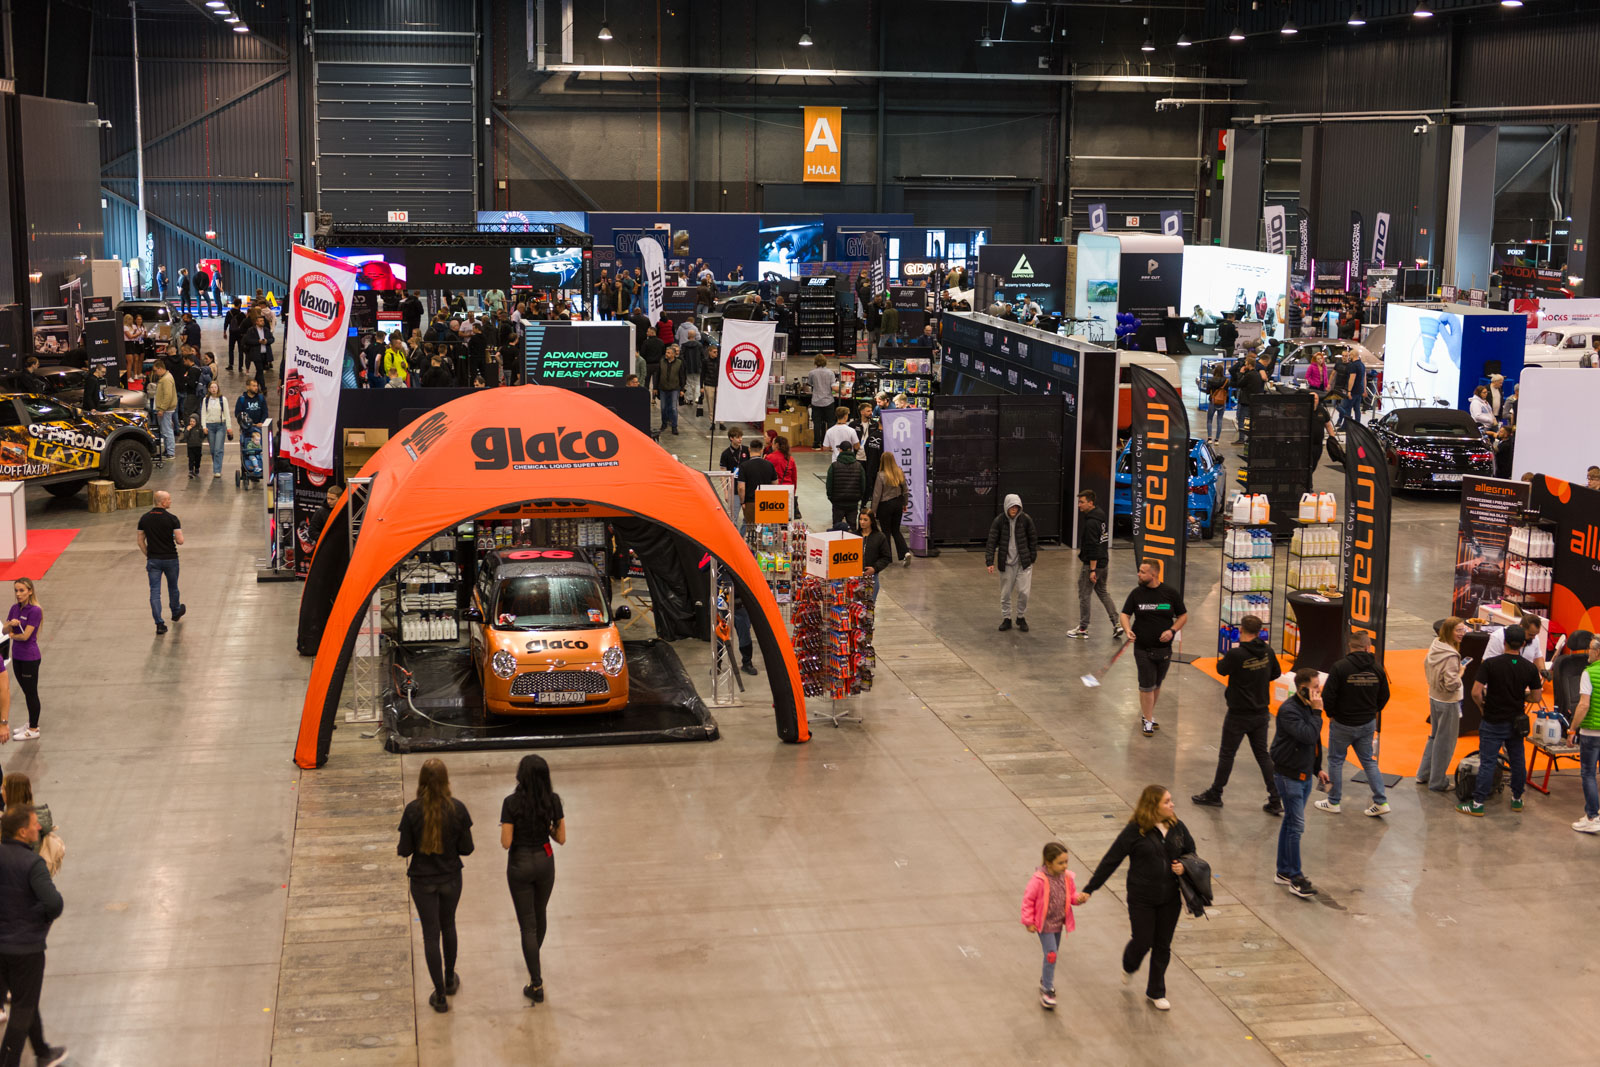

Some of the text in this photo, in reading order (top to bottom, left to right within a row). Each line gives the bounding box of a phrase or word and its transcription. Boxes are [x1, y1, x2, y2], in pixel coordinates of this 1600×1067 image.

[805, 117, 838, 153] A
[807, 165, 837, 175] HALA
[394, 212, 406, 221] 10
[1131, 216, 1139, 226] 8
[434, 262, 483, 275] NTools
[730, 356, 760, 372] Waxoyl
[39, 441, 91, 469] TAXI
